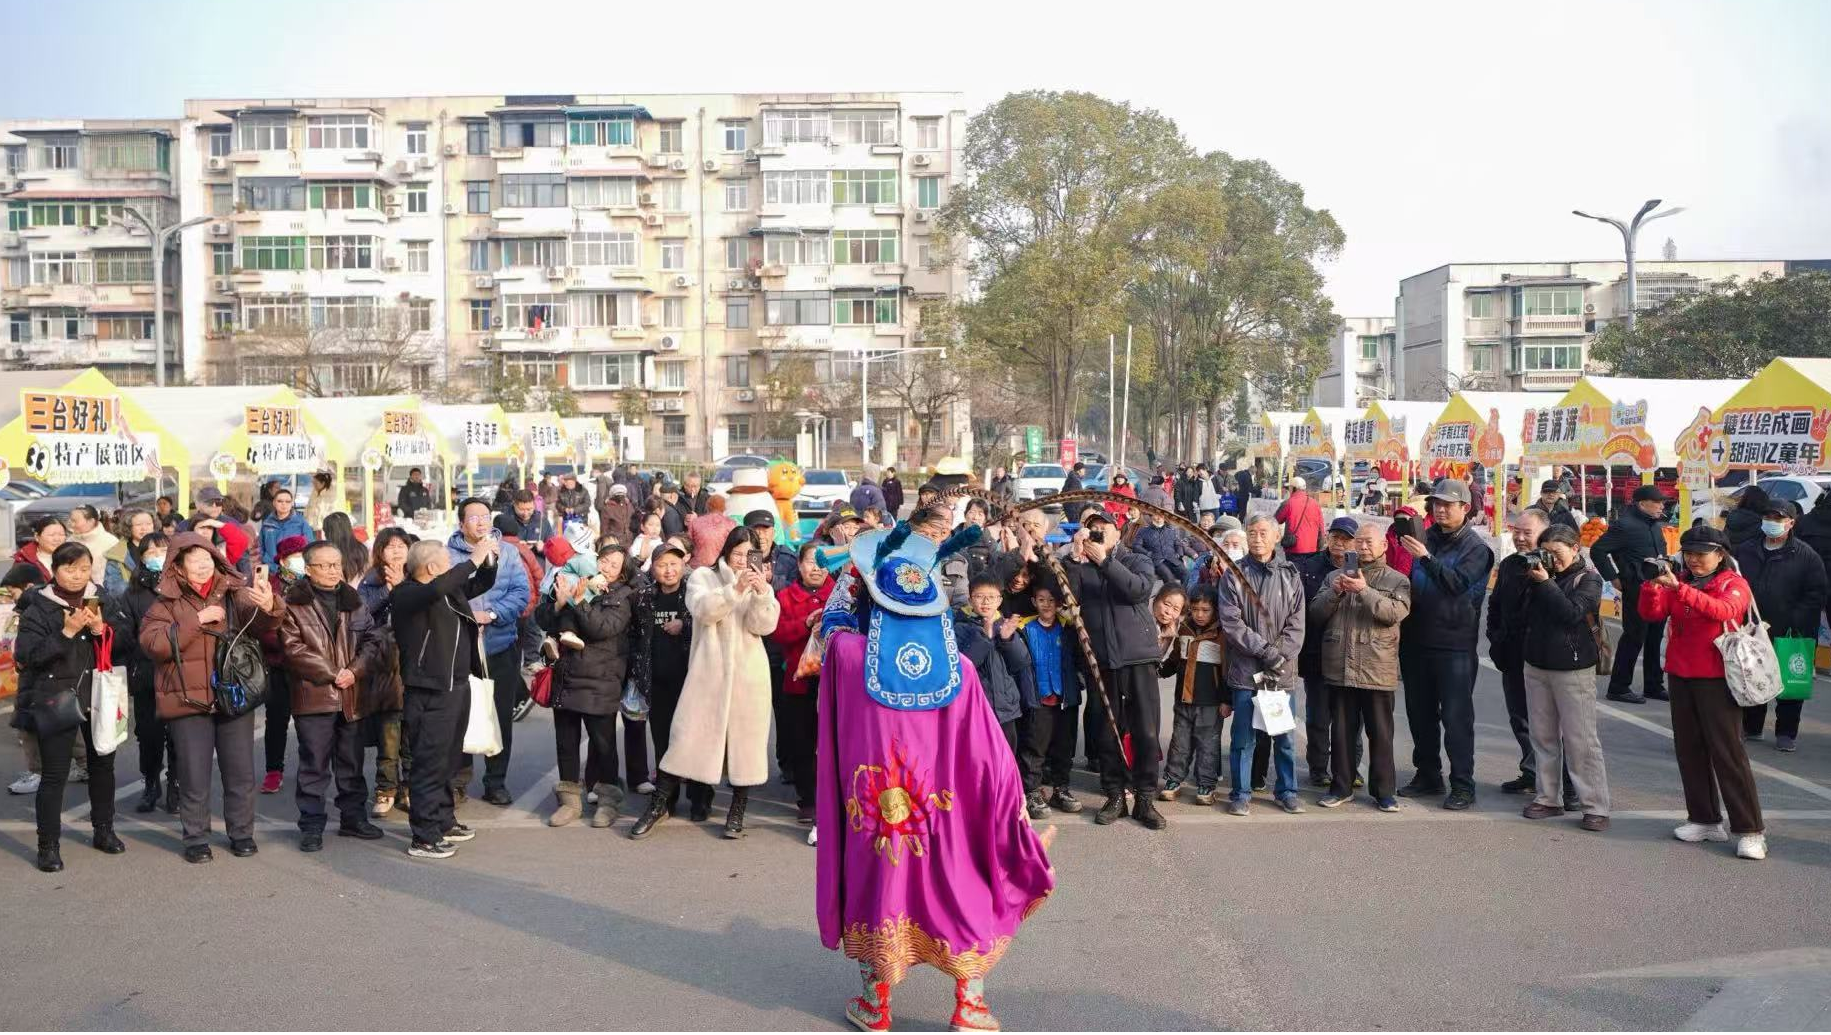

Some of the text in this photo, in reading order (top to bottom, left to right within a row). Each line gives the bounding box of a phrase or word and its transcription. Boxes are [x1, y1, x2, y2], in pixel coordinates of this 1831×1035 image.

[29, 396, 109, 432] 三台好礼
[248, 409, 294, 435] 三台好礼
[1723, 412, 1812, 435] 糖丝绘成画
[54, 442, 144, 467] 特产展销区
[262, 443, 317, 462] 特产展销区
[1729, 442, 1820, 464] 甜润忆童年
